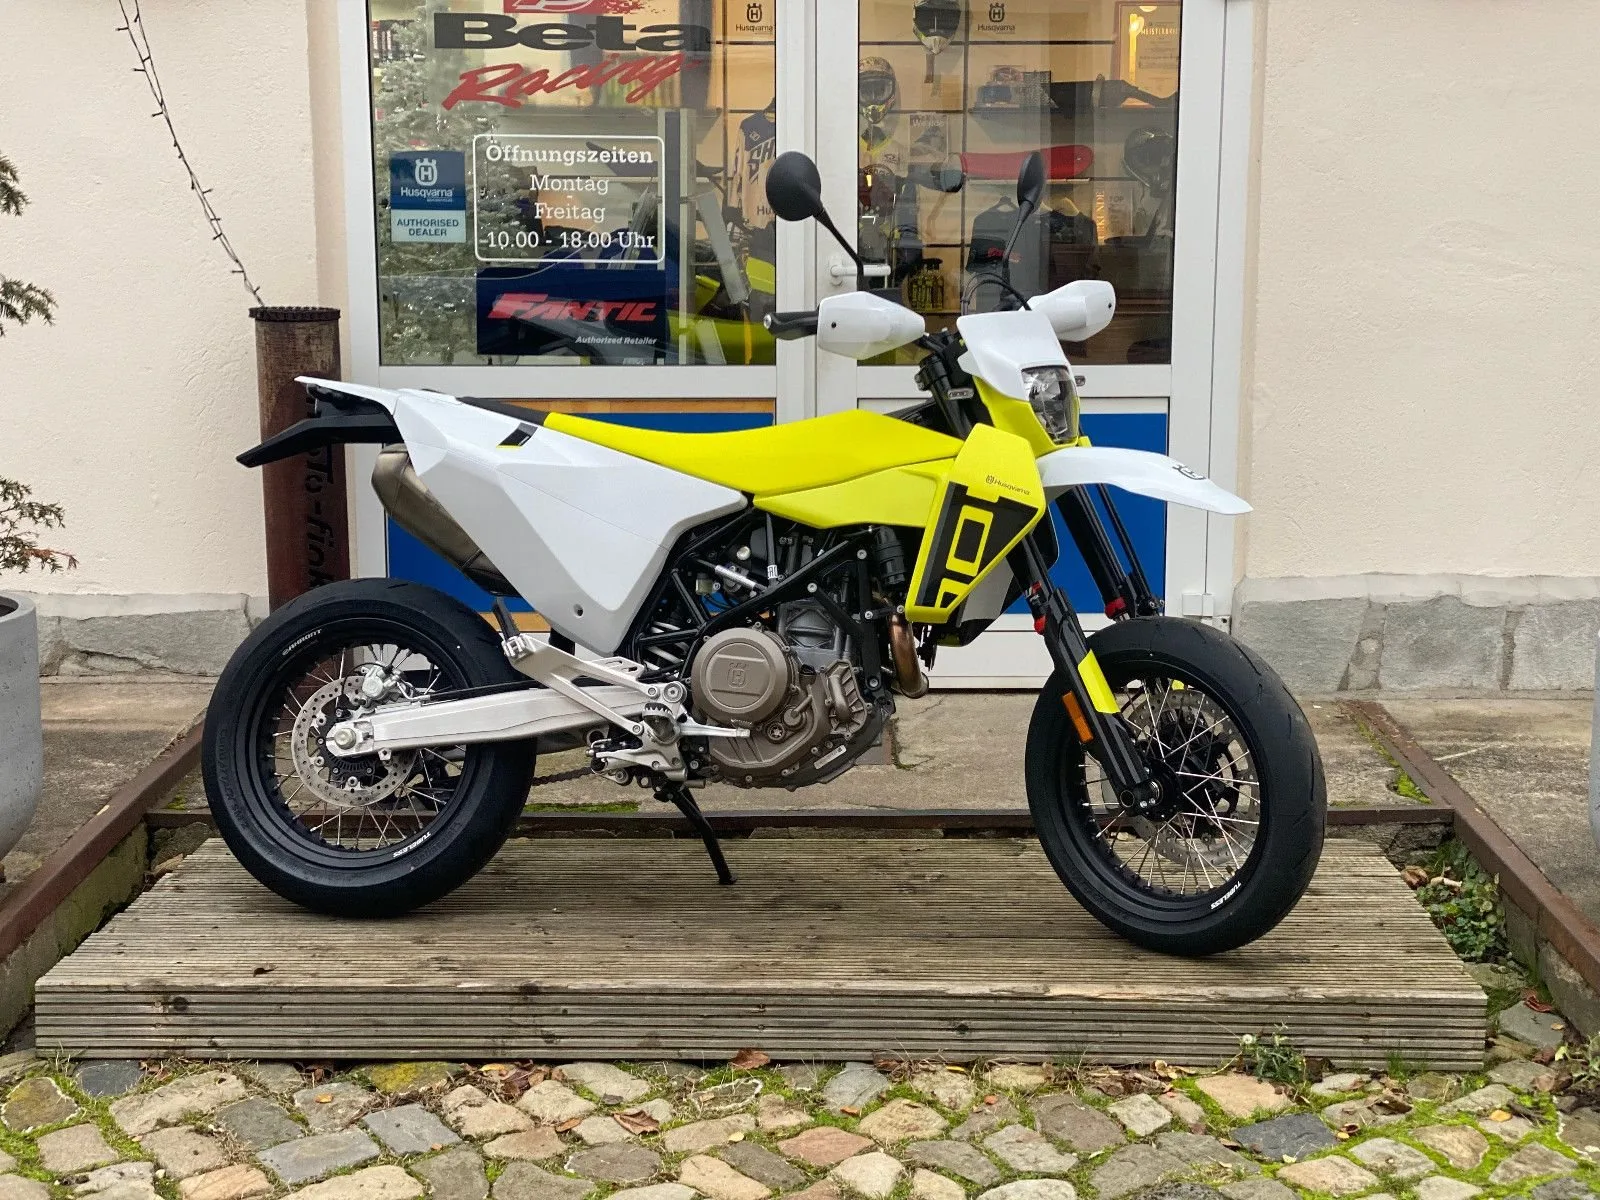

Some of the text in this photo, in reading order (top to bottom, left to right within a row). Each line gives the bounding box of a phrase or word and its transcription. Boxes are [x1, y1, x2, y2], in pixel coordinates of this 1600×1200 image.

[434, 13, 711, 51] Beta
[735, 24, 773, 33] Husqvarna
[441, 53, 686, 110] Racing
[486, 139, 653, 165] Öffnungszeiten
[401, 186, 454, 198] Husqvarna
[530, 174, 609, 195] Montag
[534, 202, 605, 222] Freitag
[397, 219, 459, 228] AUTHORISED
[408, 228, 447, 237] DEALER
[487, 231, 539, 248] 10.00
[560, 231, 611, 248] 18.00
[617, 231, 656, 248] Uhr
[487, 293, 657, 321] FANTIC
[575, 336, 657, 345] Authorized Retailer
